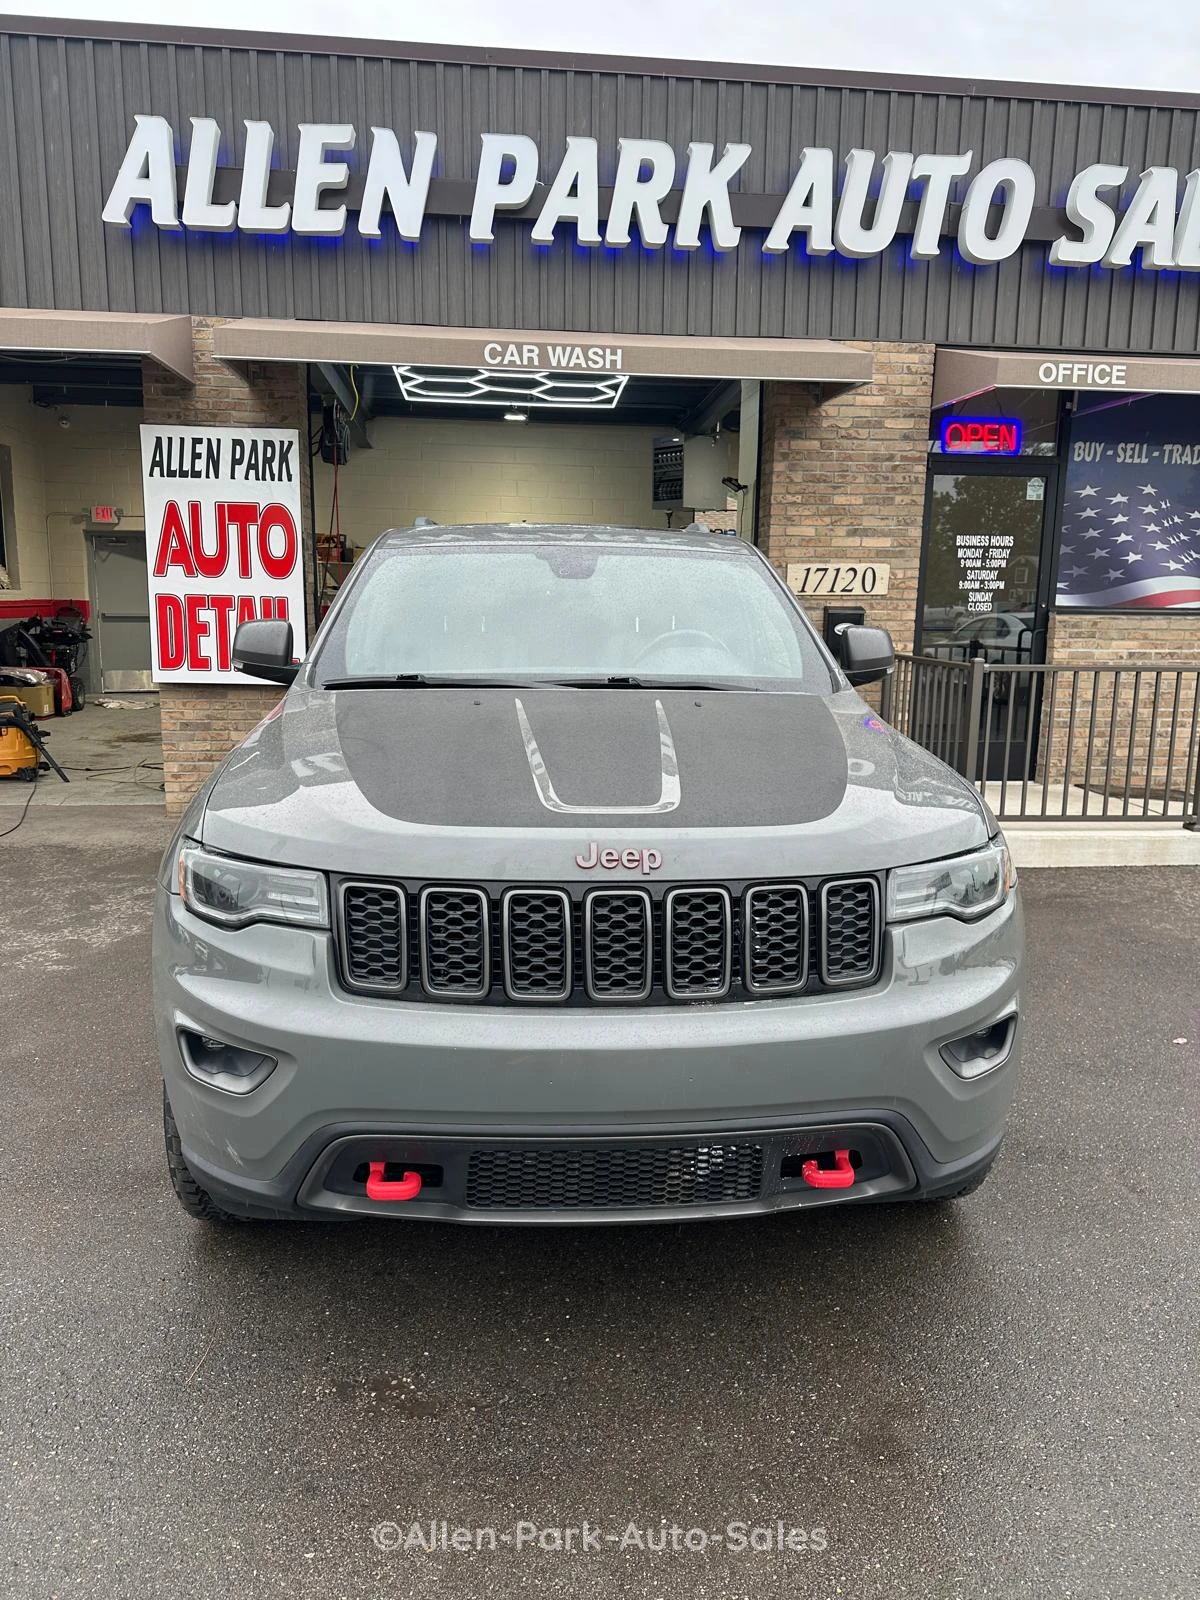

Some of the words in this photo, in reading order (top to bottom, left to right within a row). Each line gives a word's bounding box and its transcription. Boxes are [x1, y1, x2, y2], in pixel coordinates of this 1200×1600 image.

[102, 114, 437, 242] ALLEN
[469, 132, 752, 252] PARK
[761, 147, 1036, 266] AUTO
[484, 343, 539, 366] CAR
[547, 345, 623, 370] WASH
[1039, 362, 1127, 385] OFFICE
[945, 423, 1017, 452] OPEN
[149, 435, 221, 480] ALLEN
[230, 438, 294, 482] PARK
[1073, 441, 1104, 463] BUY
[1116, 442, 1149, 464] SELL
[95, 505, 113, 521] EXIT
[153, 500, 298, 579] AUTO
[956, 535, 990, 547] BUSINESS
[990, 535, 1014, 547] HOURS
[957, 548, 983, 559] MONDAY
[989, 548, 1011, 559] FRIDAY
[960, 559, 982, 568] 9:00AM
[798, 566, 877, 594] 17120
[966, 570, 999, 580] SATURDAY
[967, 602, 993, 612] CLOSED
[968, 591, 994, 602] SUNDAY
[575, 841, 662, 876] Jeep
